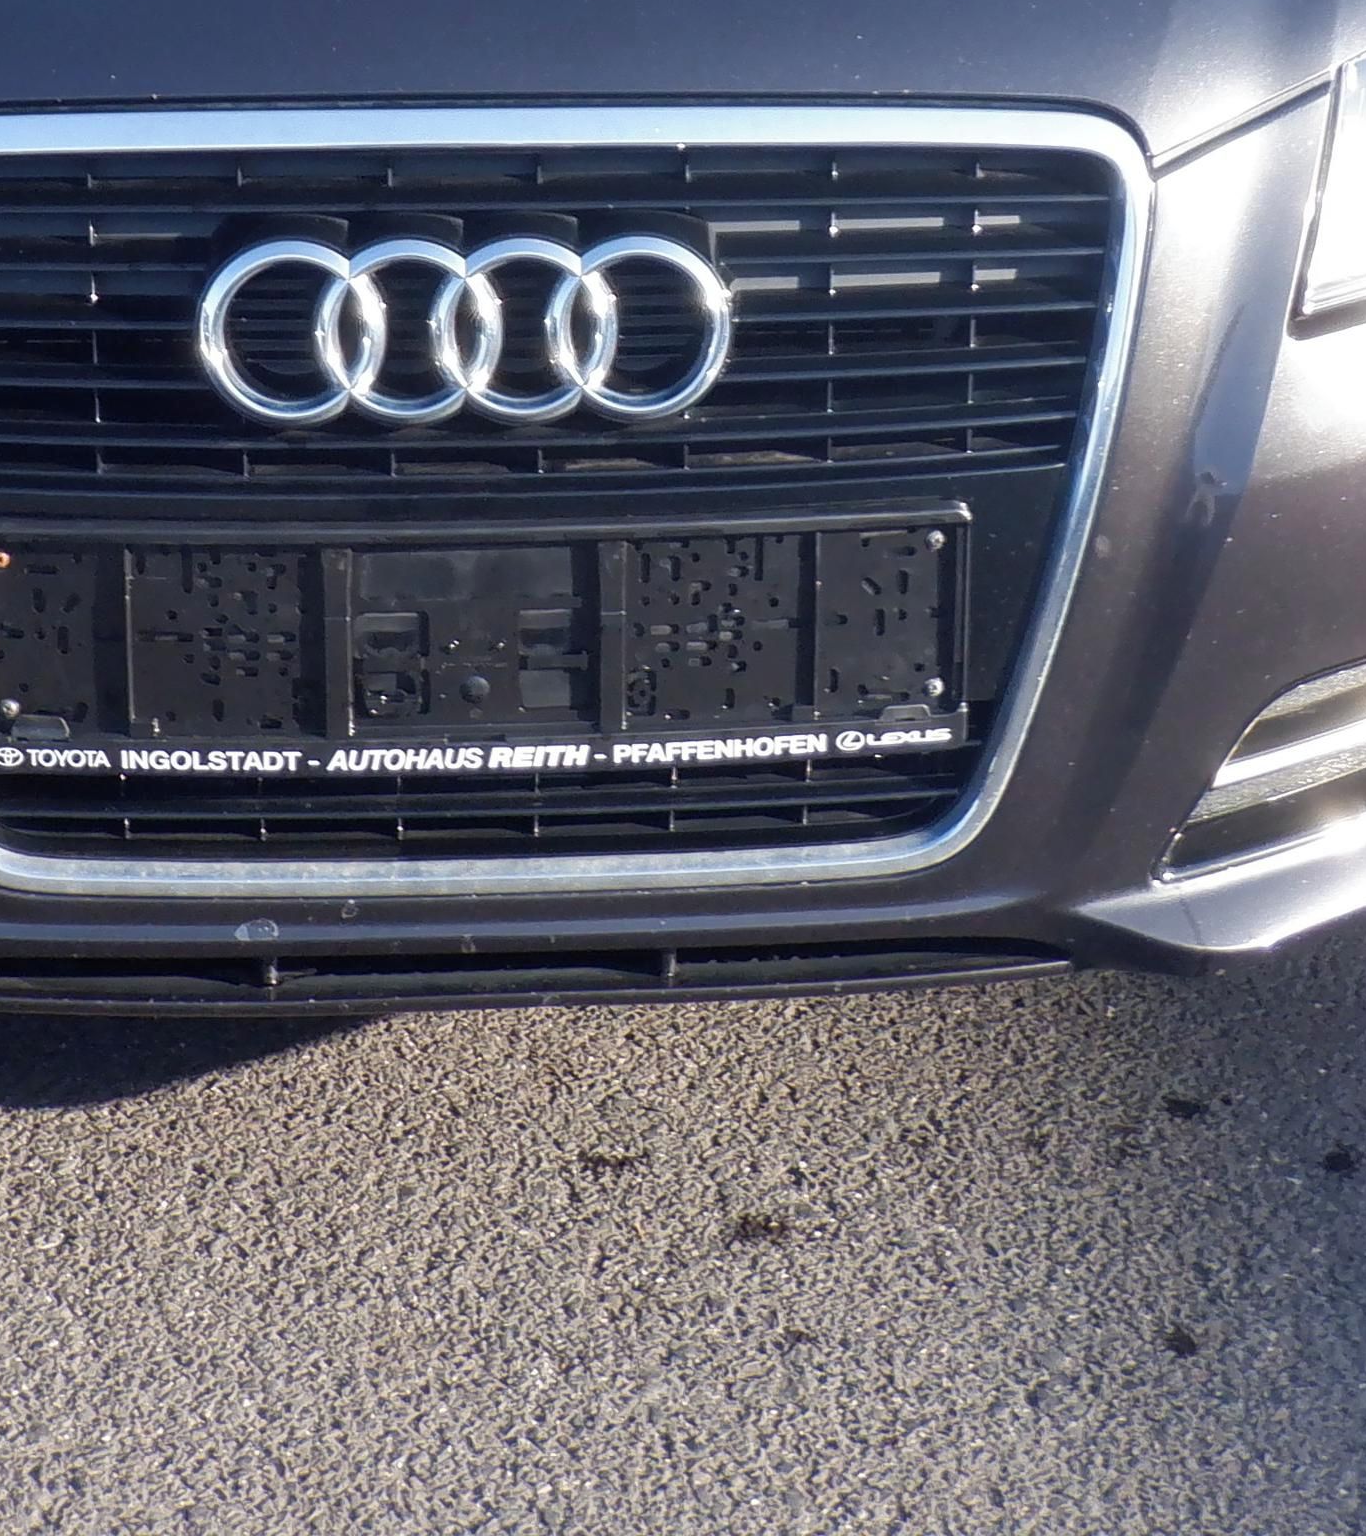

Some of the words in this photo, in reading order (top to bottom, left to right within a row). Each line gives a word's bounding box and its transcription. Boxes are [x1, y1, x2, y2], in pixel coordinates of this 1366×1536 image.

[25, 748, 112, 768] TOYOTA
[119, 749, 303, 772] INGOLSTADT
[325, 745, 485, 772] AUTOHAUS
[487, 743, 591, 769] REITH
[611, 732, 829, 765] PFAFFENHOFEN
[866, 727, 953, 747] LEXUS
